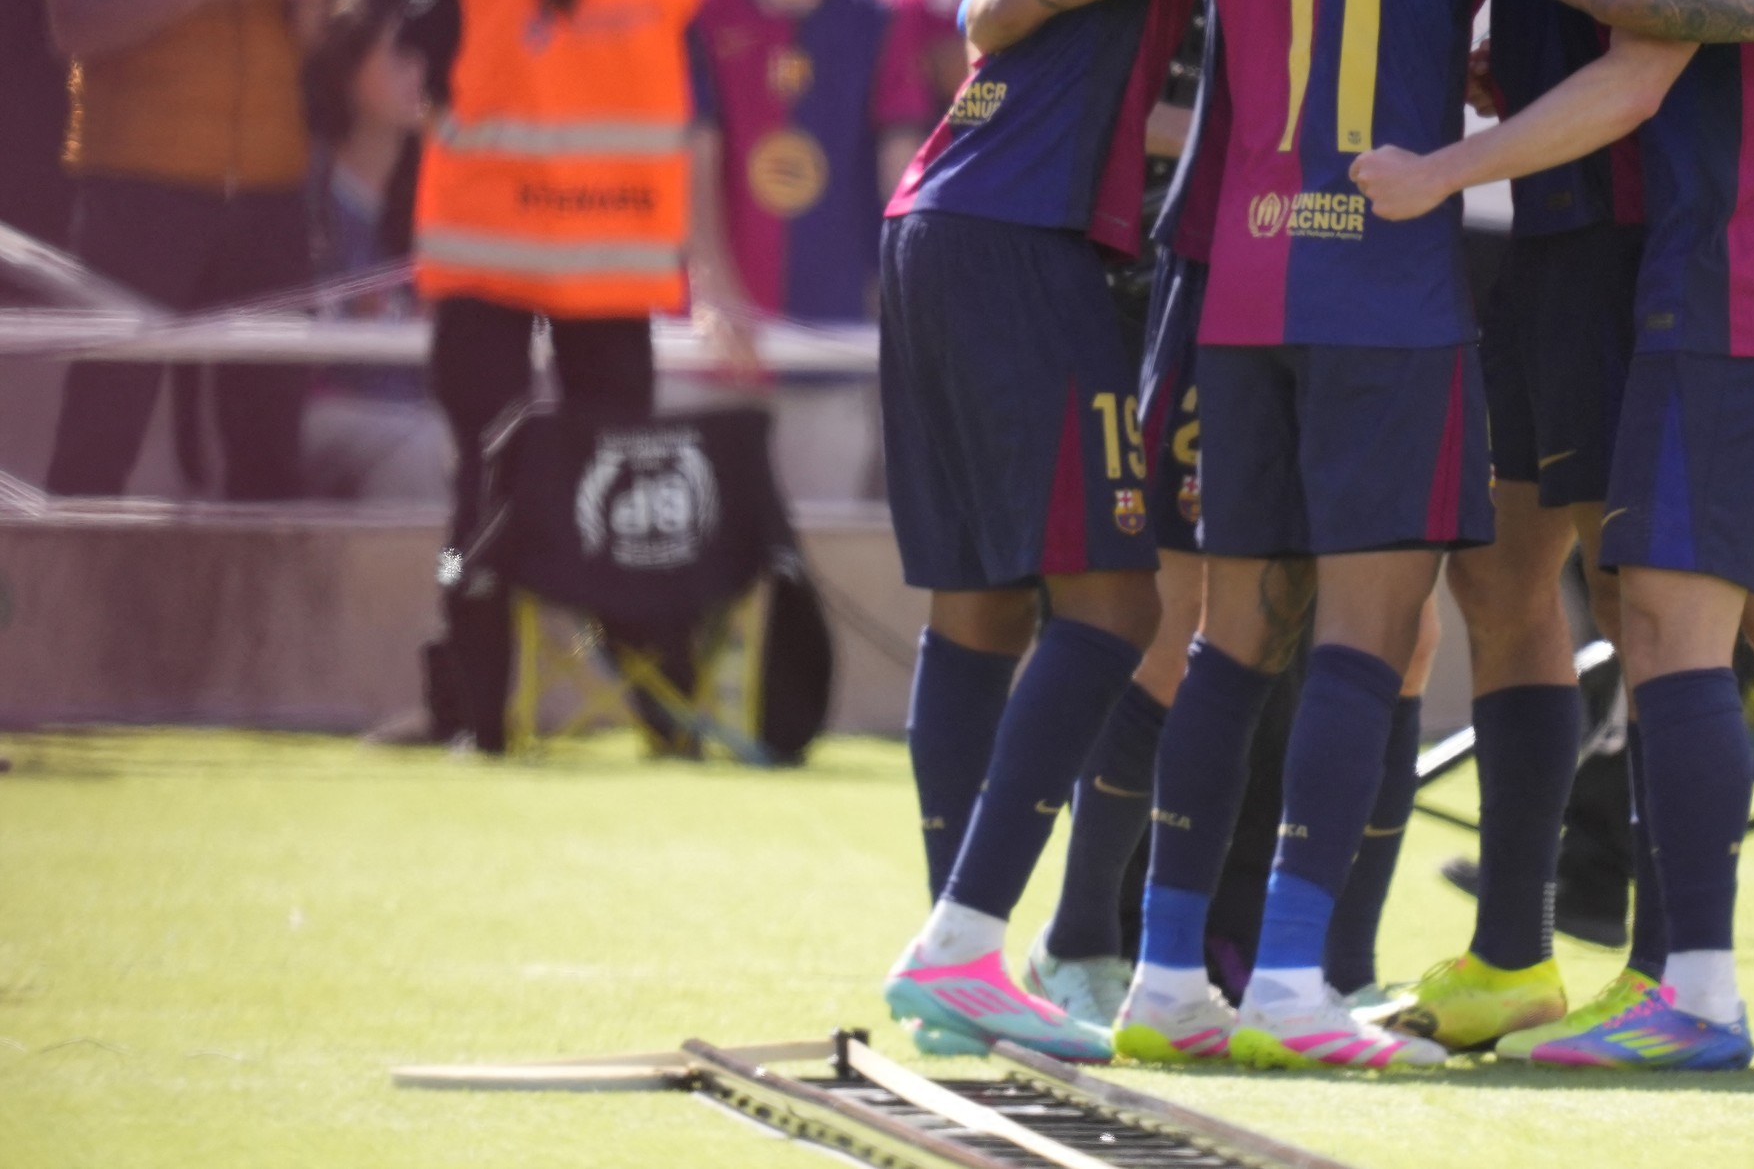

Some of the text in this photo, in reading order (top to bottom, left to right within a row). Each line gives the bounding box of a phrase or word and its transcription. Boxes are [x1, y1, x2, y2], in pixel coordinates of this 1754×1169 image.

[962, 81, 1008, 101] HCR
[1291, 192, 1366, 213] UNHCR
[1286, 210, 1364, 232] ACNUR
